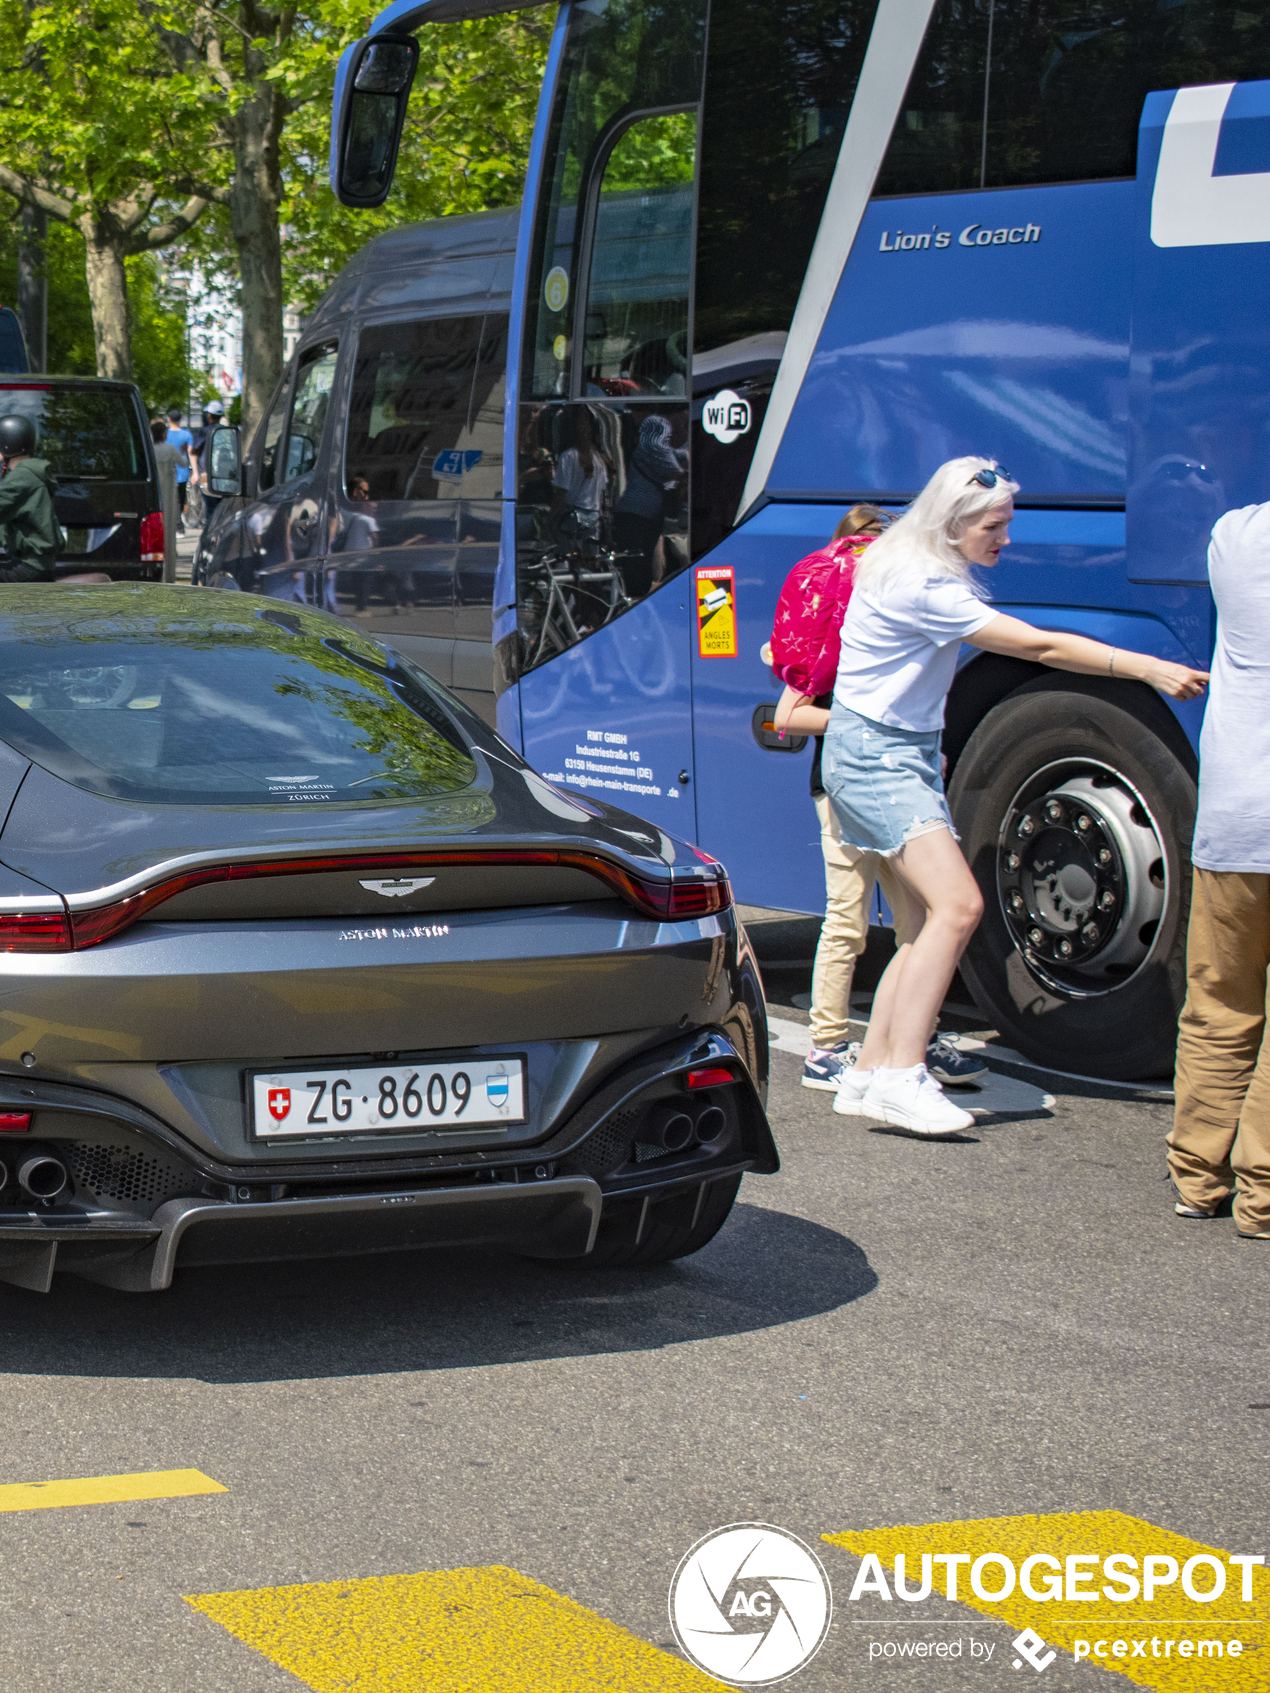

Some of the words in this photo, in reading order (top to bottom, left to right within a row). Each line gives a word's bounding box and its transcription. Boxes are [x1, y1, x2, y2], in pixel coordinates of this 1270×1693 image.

[879, 224, 951, 252] Lion's
[958, 222, 1042, 247] Coach
[697, 569, 732, 579] ATTENTION
[704, 631, 730, 640] ANGLES
[706, 641, 730, 649] MORTS
[587, 730, 603, 742] RMT
[604, 732, 628, 745] GMBH
[576, 744, 628, 761] Industriestraße
[629, 751, 641, 762] 1G
[565, 758, 585, 770] 63150
[586, 761, 636, 777] Heusenstamm
[636, 767, 653, 781] (DE)
[339, 928, 388, 941] ASTON
[392, 925, 449, 939] MARTIN
